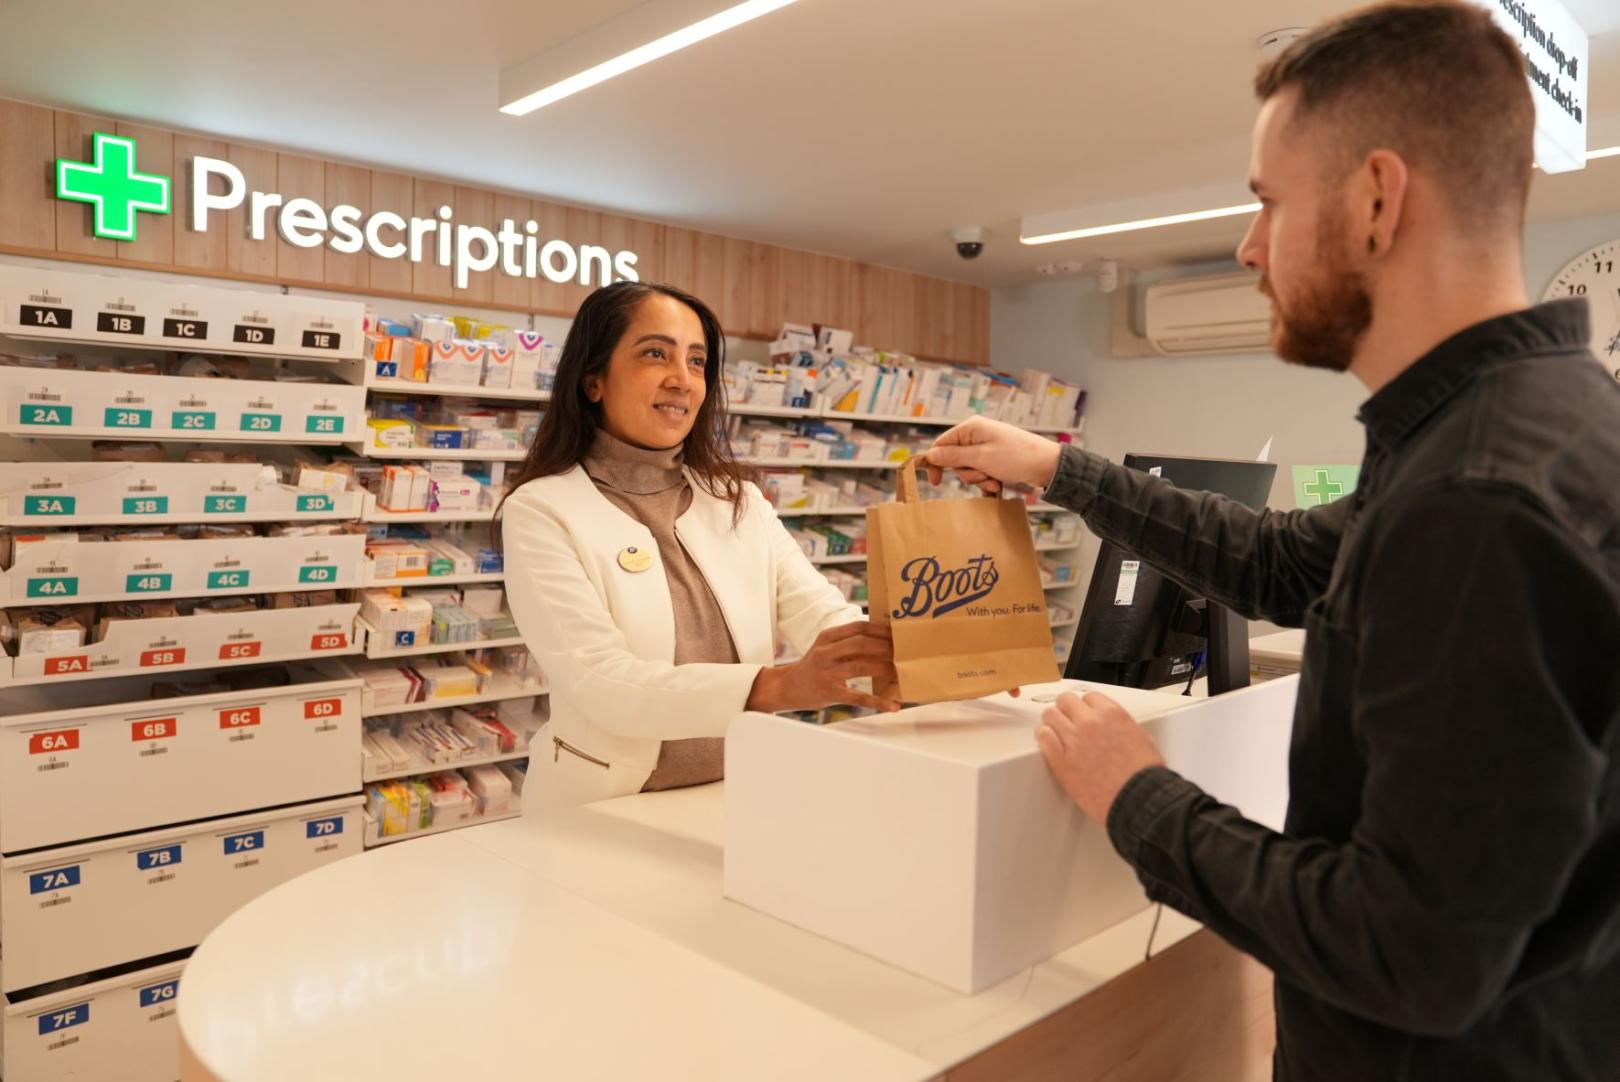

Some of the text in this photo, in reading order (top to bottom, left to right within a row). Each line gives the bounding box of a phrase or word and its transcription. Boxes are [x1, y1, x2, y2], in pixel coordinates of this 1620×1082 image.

[1499, 0, 1546, 48] escription
[191, 155, 640, 289] Prescriptions
[1594, 261, 1613, 274] 11
[1567, 284, 1587, 296] 10
[35, 310, 58, 325] 1A
[111, 317, 132, 331] 1B
[176, 323, 195, 336] 1C
[245, 329, 264, 342] 1D
[314, 334, 330, 347] 1E
[382, 365, 390, 375] A
[33, 409, 60, 423] 2A
[117, 412, 141, 426] 2B
[183, 415, 205, 428] 2C
[250, 417, 272, 429] 2D
[316, 419, 335, 431] 2E
[37, 500, 63, 512] 3A
[135, 500, 157, 513] 3B
[216, 498, 236, 511] 3C
[306, 498, 325, 511] 3D
[217, 573, 239, 586] 4C
[308, 569, 329, 580] 4D
[39, 581, 67, 594] 4A
[137, 577, 161, 589] 4B
[892, 554, 999, 619] Boots
[966, 605, 990, 616] With
[1012, 603, 1026, 614] For
[321, 636, 340, 648] 5D
[401, 634, 409, 644] C
[230, 645, 250, 657] 5C
[152, 652, 174, 664] 5B
[57, 659, 82, 672] 5A
[313, 703, 333, 715] 6D
[230, 712, 250, 725] 6C
[143, 723, 166, 737] 6B
[41, 735, 68, 749] 6A
[316, 822, 335, 834] 7D
[234, 836, 254, 850] 7C
[149, 851, 171, 866] 7B
[42, 872, 69, 889] 7A
[151, 985, 174, 1001] 7G
[53, 1010, 77, 1028] 7F
